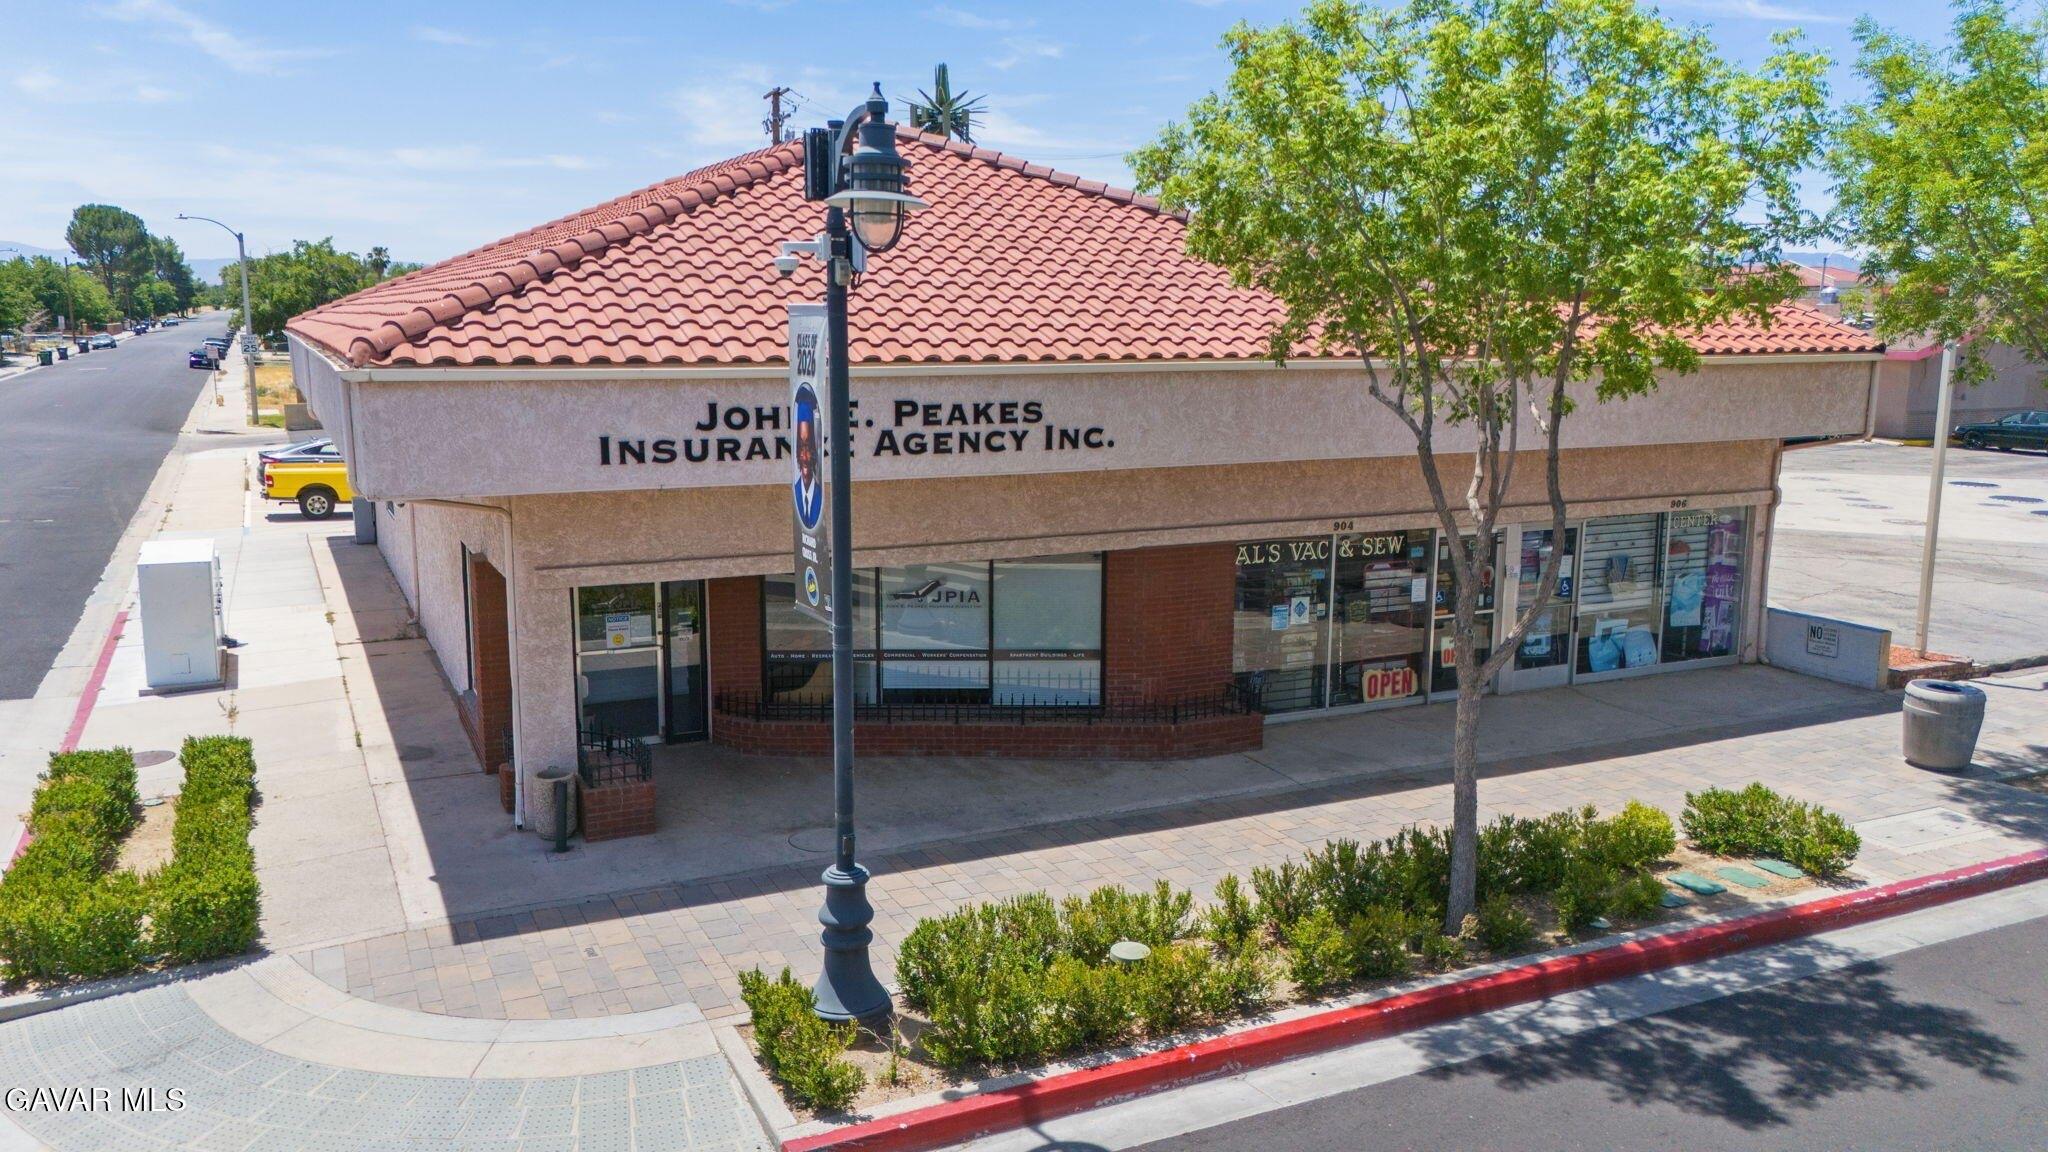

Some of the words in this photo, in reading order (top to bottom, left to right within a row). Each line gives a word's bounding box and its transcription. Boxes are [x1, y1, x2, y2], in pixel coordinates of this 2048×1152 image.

[243, 344, 258, 352] 25
[797, 333, 811, 348] CLASS
[797, 349, 816, 378] 2026
[696, 403, 791, 431] JOH
[894, 400, 1043, 427] PEAKES
[599, 435, 855, 465] INSURAN
[873, 429, 1030, 456] AGENCY
[1045, 425, 1115, 450] INC.
[1670, 500, 1687, 508] 906
[1334, 521, 1354, 531] 904
[1673, 513, 1719, 528] CENTER
[1235, 543, 1281, 566] AL'S
[1289, 541, 1329, 561] VAC
[1339, 538, 1354, 558] &
[1362, 535, 1406, 556] SEW
[932, 590, 980, 603] JPIA
[1810, 625, 1823, 640] NO
[1443, 648, 1457, 664] OP
[1367, 669, 1413, 699] OPEN
